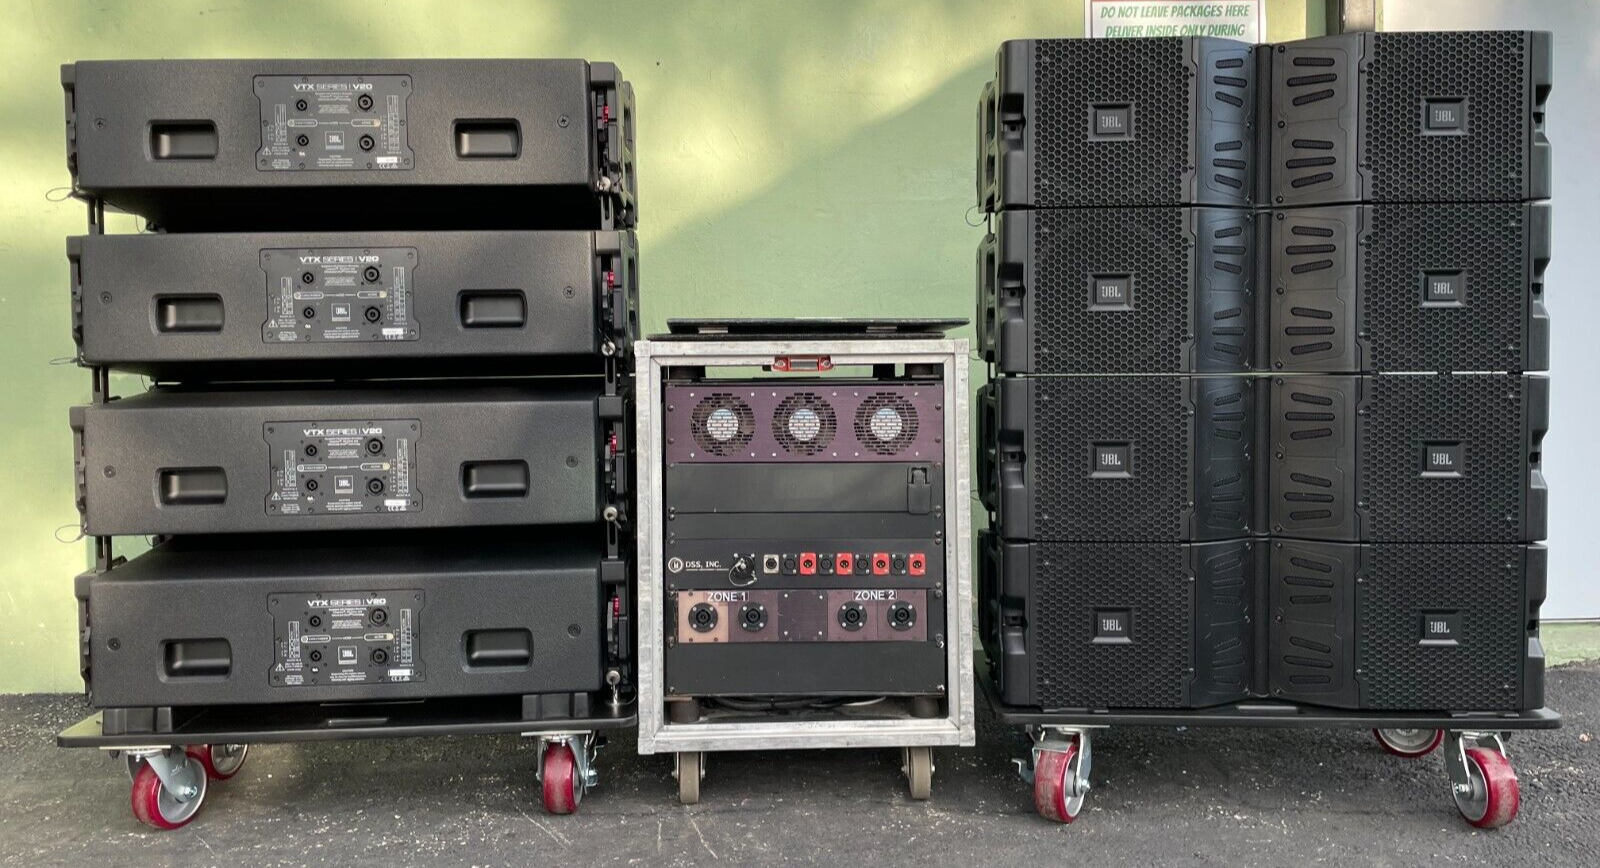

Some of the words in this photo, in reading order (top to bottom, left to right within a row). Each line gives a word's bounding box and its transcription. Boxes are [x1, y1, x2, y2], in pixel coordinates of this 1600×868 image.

[1100, 6, 1116, 18] DO
[1117, 6, 1138, 18] NOT
[1140, 6, 1169, 17] LEAVE
[1171, 5, 1223, 17] PACKAGES
[1225, 4, 1250, 16] HERE
[1106, 25, 1142, 37] DELIVER
[1146, 25, 1178, 37] INSIDE
[1180, 25, 1206, 36] ONLY
[1208, 24, 1245, 36] DURING
[1102, 116, 1121, 128] JBL
[1436, 110, 1455, 122] JBL
[1102, 286, 1121, 297] JBL
[1434, 282, 1453, 294] JBL
[1101, 454, 1121, 465] JBL
[1432, 453, 1452, 465] JBL
[685, 561, 703, 569] DSS,
[707, 592, 738, 601] ZONE
[741, 592, 746, 601] 1
[855, 591, 885, 600] ZONE
[888, 590, 895, 599] 2
[1103, 619, 1122, 631] JBL
[1431, 621, 1450, 633] JBL
